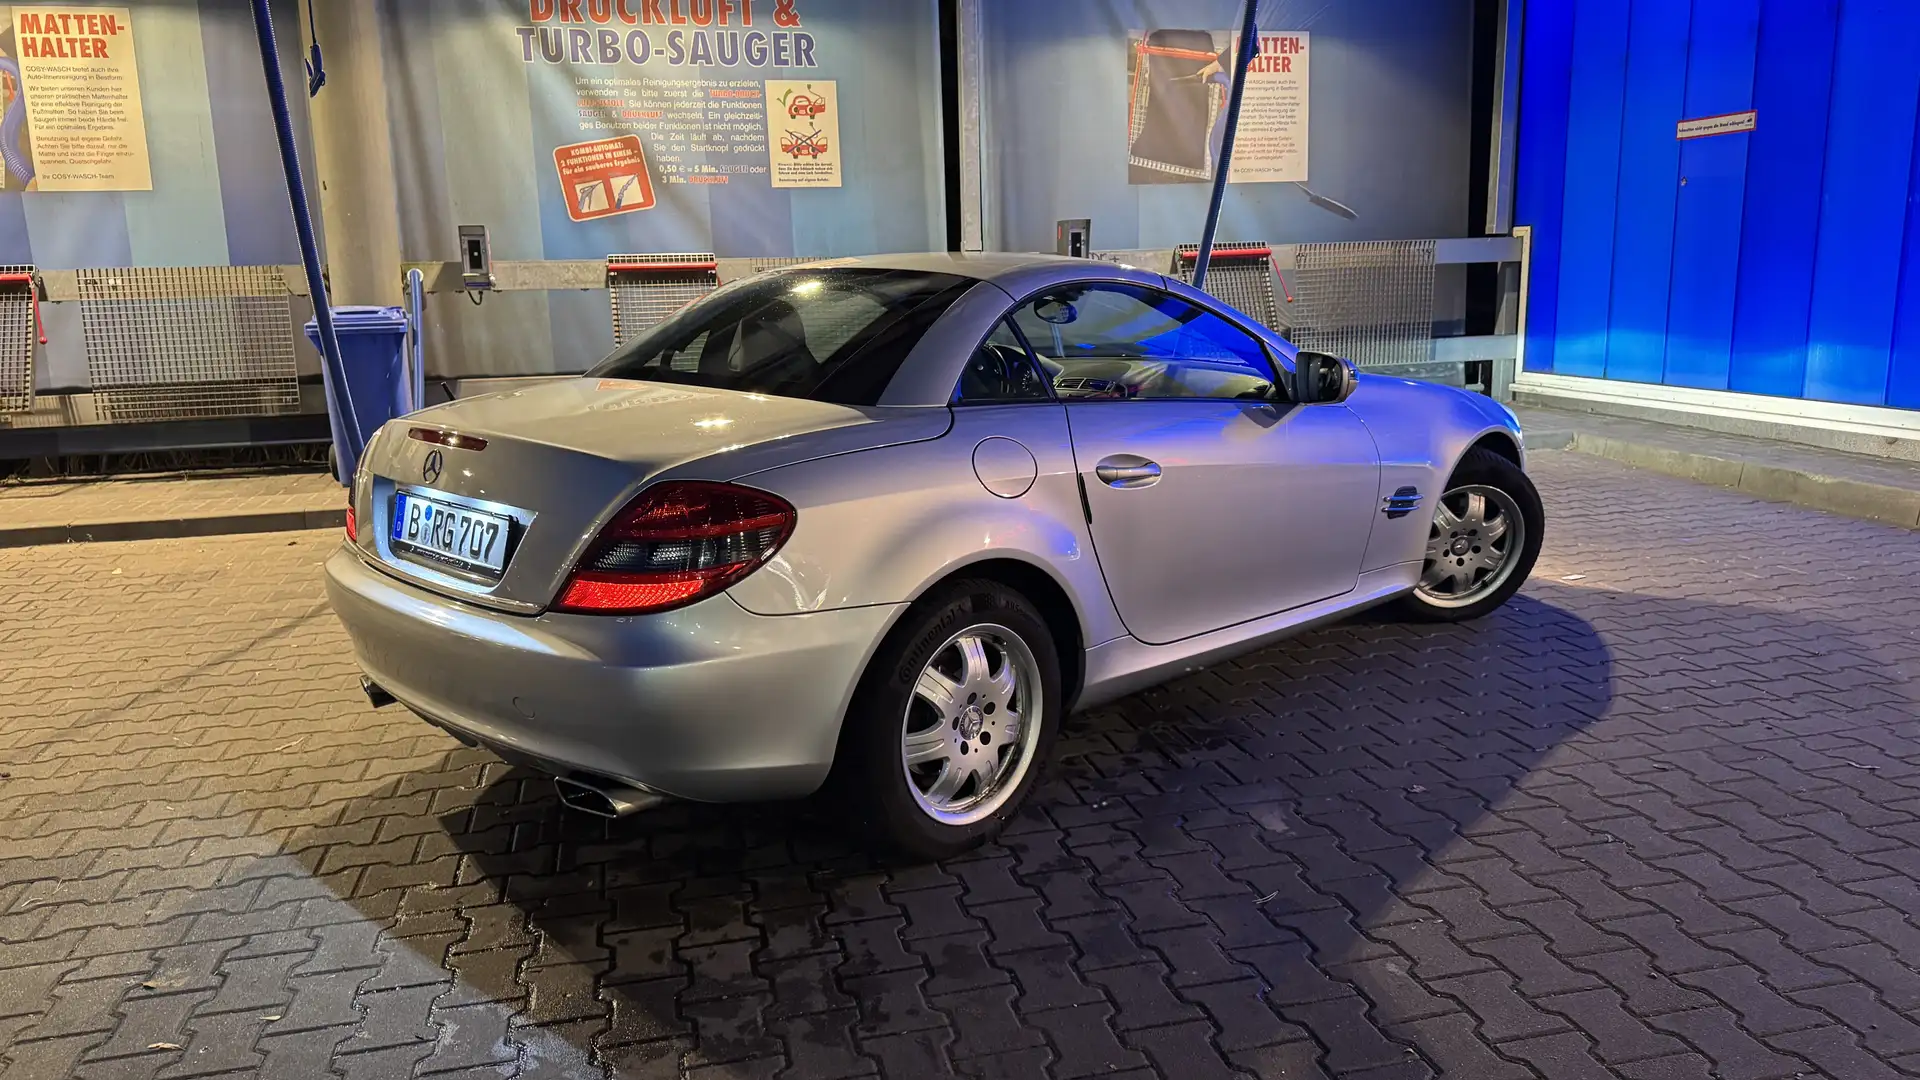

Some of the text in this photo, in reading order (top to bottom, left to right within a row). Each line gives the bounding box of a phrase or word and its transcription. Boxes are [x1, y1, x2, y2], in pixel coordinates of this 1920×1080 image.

[530, 0, 803, 28] DRUCKLUFT &
[20, 13, 124, 36] MATTEN-
[22, 37, 109, 59] HALTER
[515, 25, 818, 69] TURBO-SAUGER
[1247, 55, 1291, 73] ALTER
[575, 76, 588, 85] Um
[590, 76, 602, 85] ein
[604, 77, 641, 87] optimales
[642, 77, 717, 88] Reinigungsergebnis
[729, 80, 761, 88] erzielen,
[576, 88, 618, 97] verwenden
[624, 88, 636, 97] Sie
[642, 88, 658, 97] bitte
[664, 89, 687, 97] zuerst
[692, 90, 704, 98] die
[629, 100, 641, 108] Sie
[644, 99, 671, 109] können
[673, 100, 706, 110] jederzeit
[708, 100, 719, 109] die
[722, 100, 762, 109] Funktionen
[667, 111, 704, 120] wechseln.
[708, 111, 720, 120] Ein
[579, 122, 593, 130] ges
[596, 121, 632, 129] Benutzen
[633, 121, 656, 130] beider
[660, 121, 700, 130] Funktionen
[733, 123, 763, 132] möglich.
[651, 133, 764, 142] Die Zeit läuft ab, nachdem
[570, 141, 624, 156] KOMBI-AUTOMAT:
[654, 143, 765, 154] Sie den Startknopf gedrückt
[567, 154, 604, 166] FUNKTIONEN
[613, 149, 632, 158] EINEM
[563, 156, 640, 176] für ein sauberes Ergebnis
[659, 165, 677, 174] 0,50
[679, 165, 685, 173] €
[694, 165, 699, 173] 5
[701, 165, 718, 173] Min.
[750, 165, 767, 173] oder
[662, 176, 667, 184] 3
[670, 176, 686, 184] Min.
[408, 503, 421, 542] B
[430, 509, 456, 553] RG
[458, 516, 499, 563] 707
[898, 608, 956, 684] Continental
